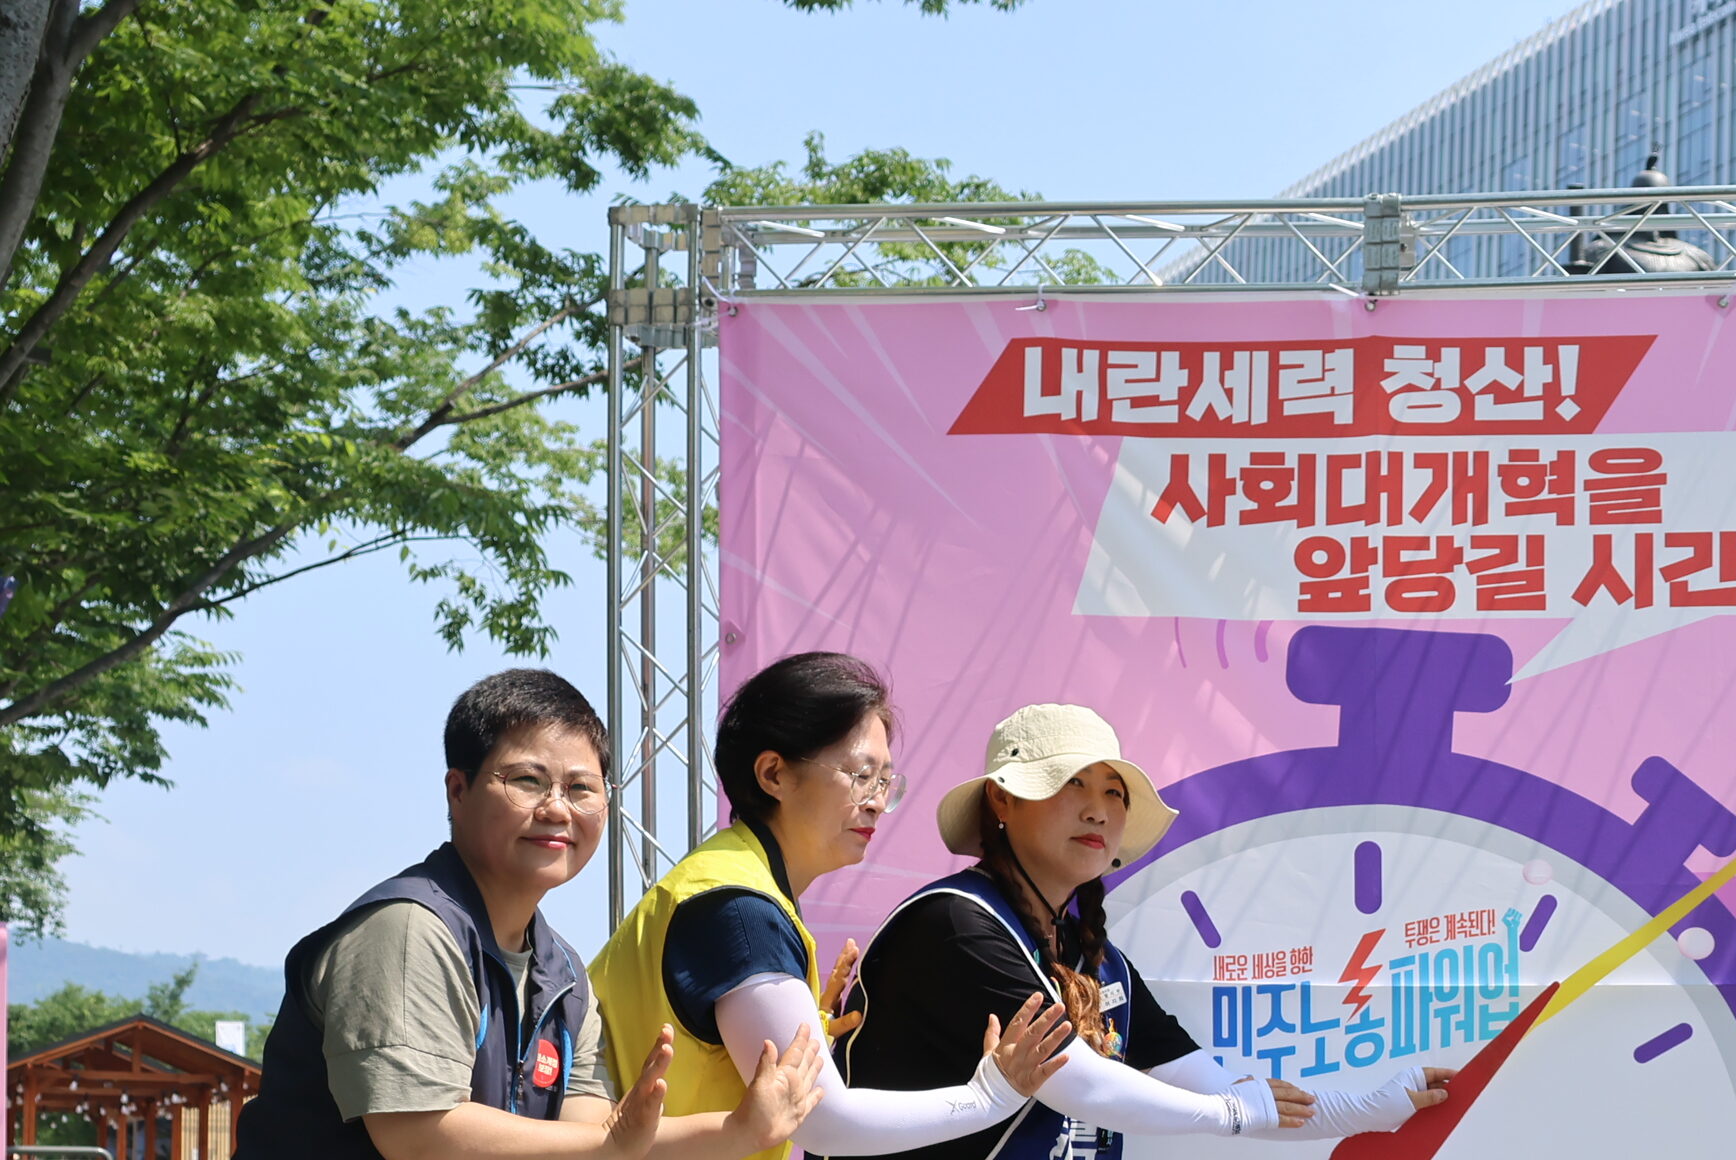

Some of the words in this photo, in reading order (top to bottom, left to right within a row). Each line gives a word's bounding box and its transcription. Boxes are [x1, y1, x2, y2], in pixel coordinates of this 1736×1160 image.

[1022, 346, 1355, 425] 내란세력
[1379, 344, 1583, 424] 청산!
[1150, 446, 1668, 529] 사회대개혁을
[1293, 532, 1547, 613] 앞당길
[1213, 954, 1248, 981] 새로운
[1252, 950, 1287, 980] 세상을
[1290, 946, 1313, 974] 향한
[1405, 916, 1440, 948] 투쟁은
[1444, 908, 1496, 940] 계속된다!
